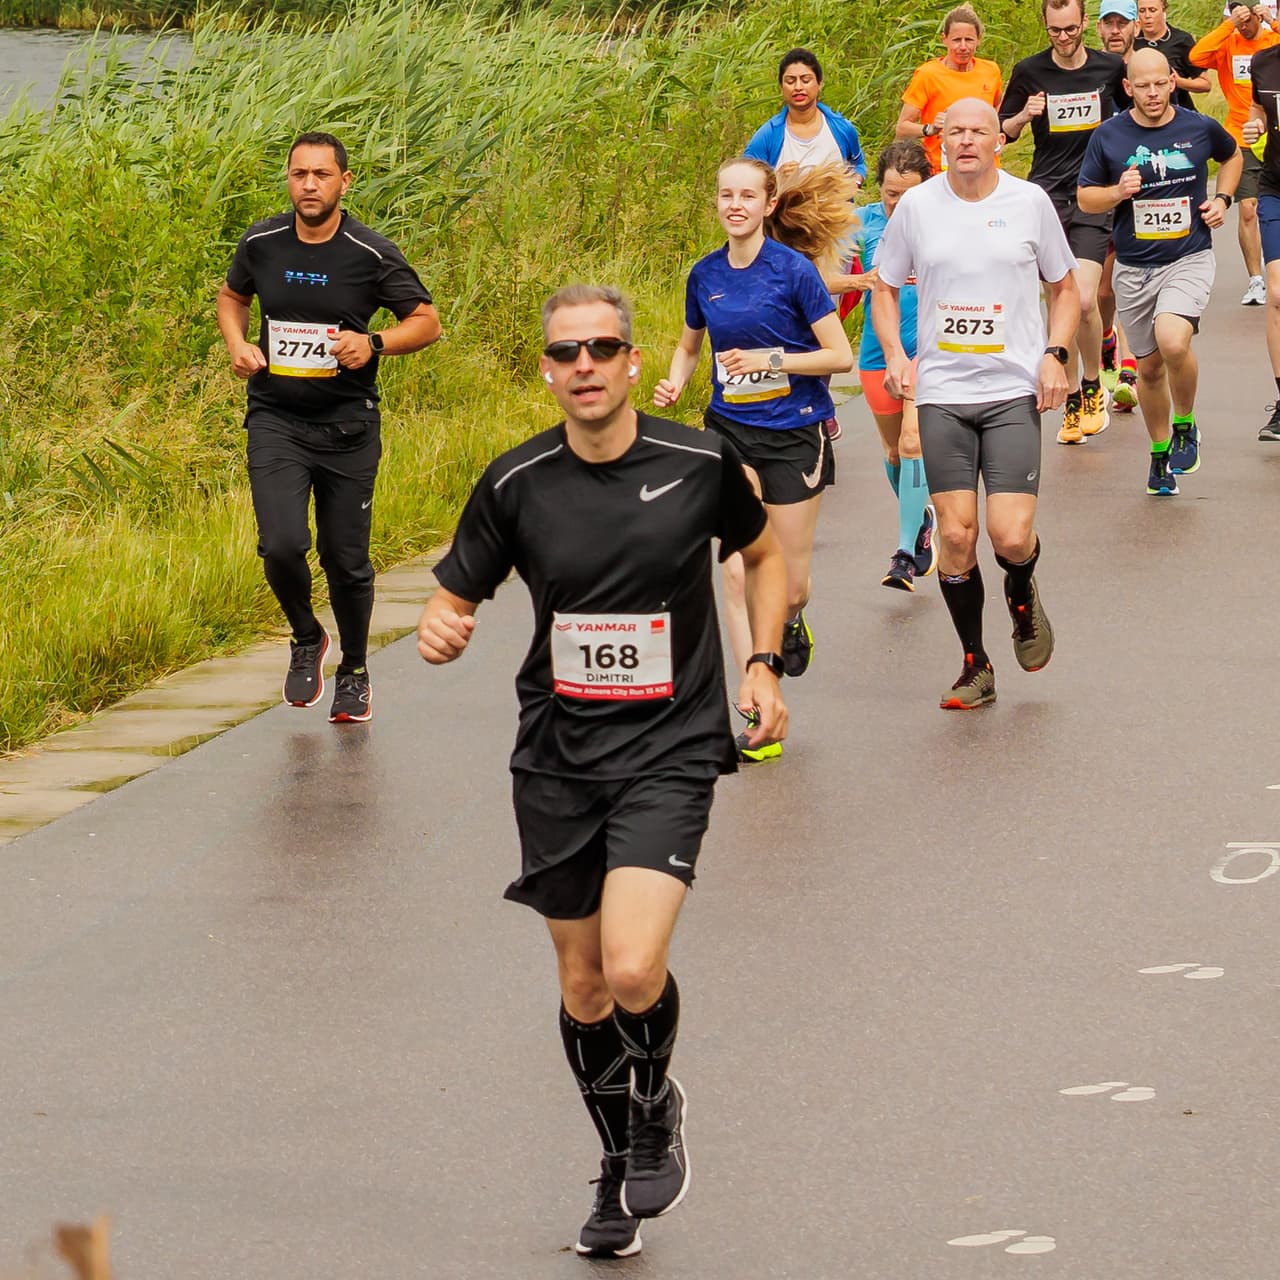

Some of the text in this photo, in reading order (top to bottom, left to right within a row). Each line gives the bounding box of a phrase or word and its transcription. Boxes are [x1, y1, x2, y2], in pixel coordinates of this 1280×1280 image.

[1057, 105, 1092, 120] 2717
[1143, 212, 1182, 225] 2142
[950, 304, 986, 312] YANMAR
[283, 327, 319, 335] YANMAR
[943, 318, 994, 335] 2673
[277, 340, 327, 358] 2774
[576, 623, 637, 632] YANMAR
[579, 643, 639, 669] 168
[586, 673, 634, 683] DIMITRI
